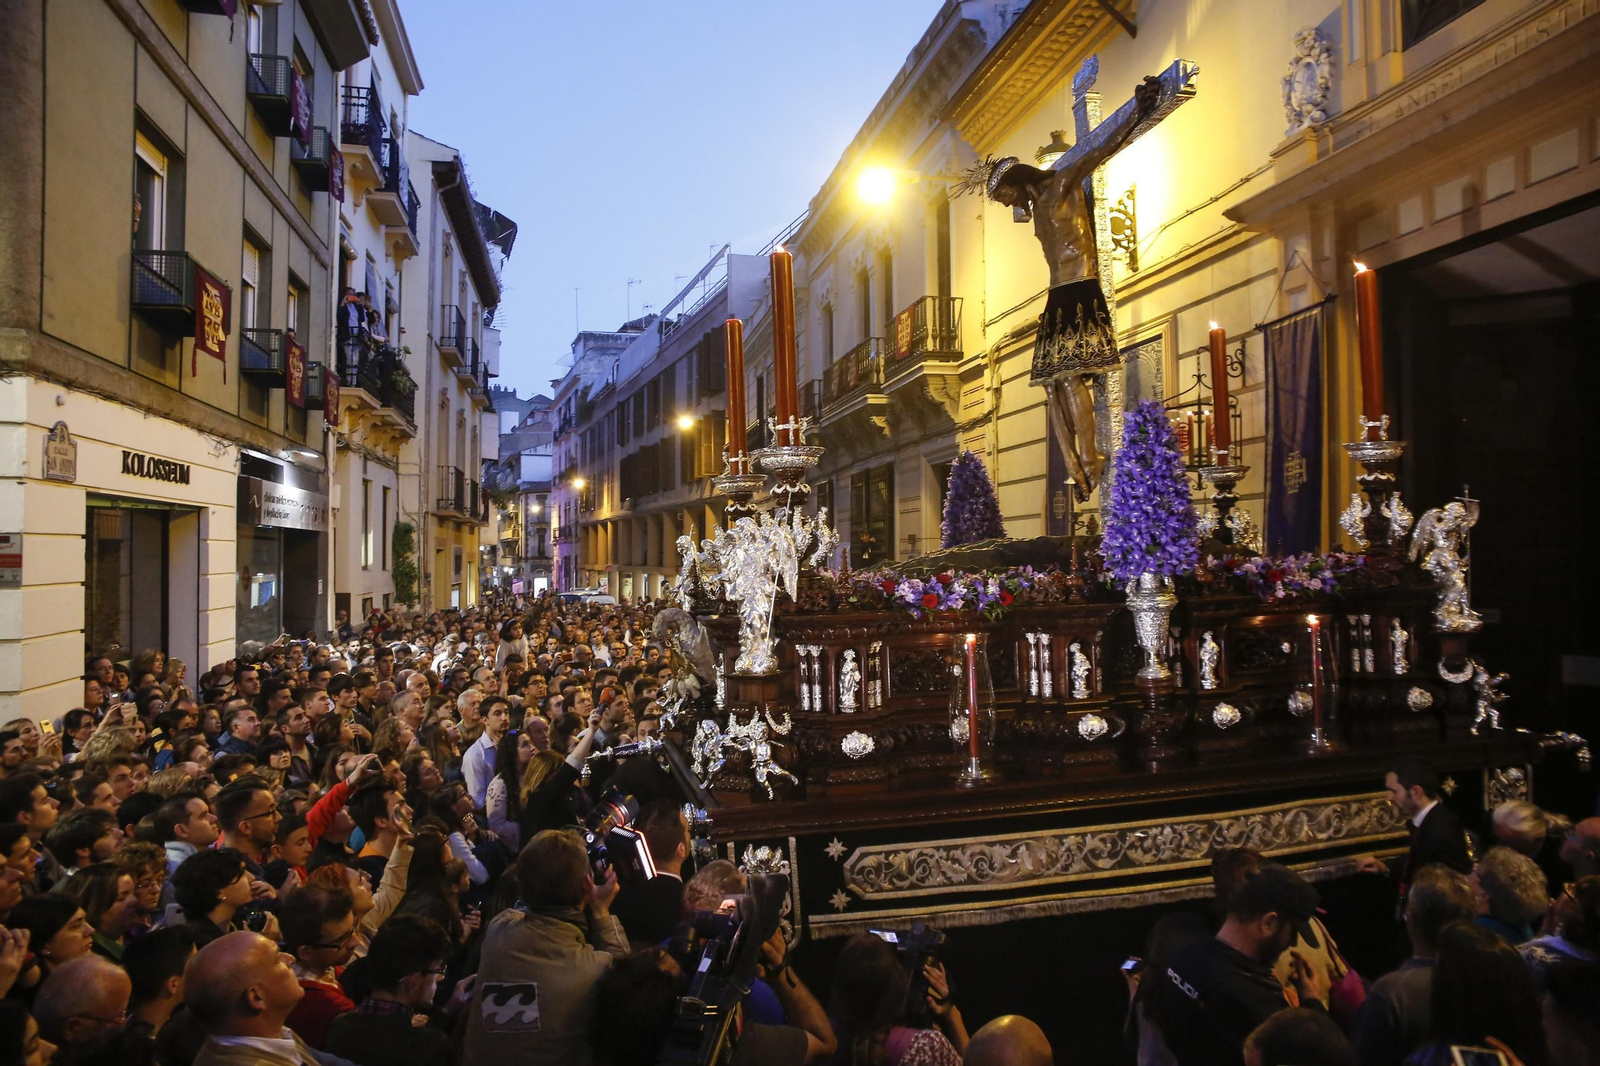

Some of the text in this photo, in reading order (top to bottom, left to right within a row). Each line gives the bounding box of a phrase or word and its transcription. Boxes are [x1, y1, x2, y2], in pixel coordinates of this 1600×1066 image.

[54, 446, 68, 456] CALLE
[47, 456, 57, 471] SAN
[121, 450, 190, 485] KOLOSSEUM
